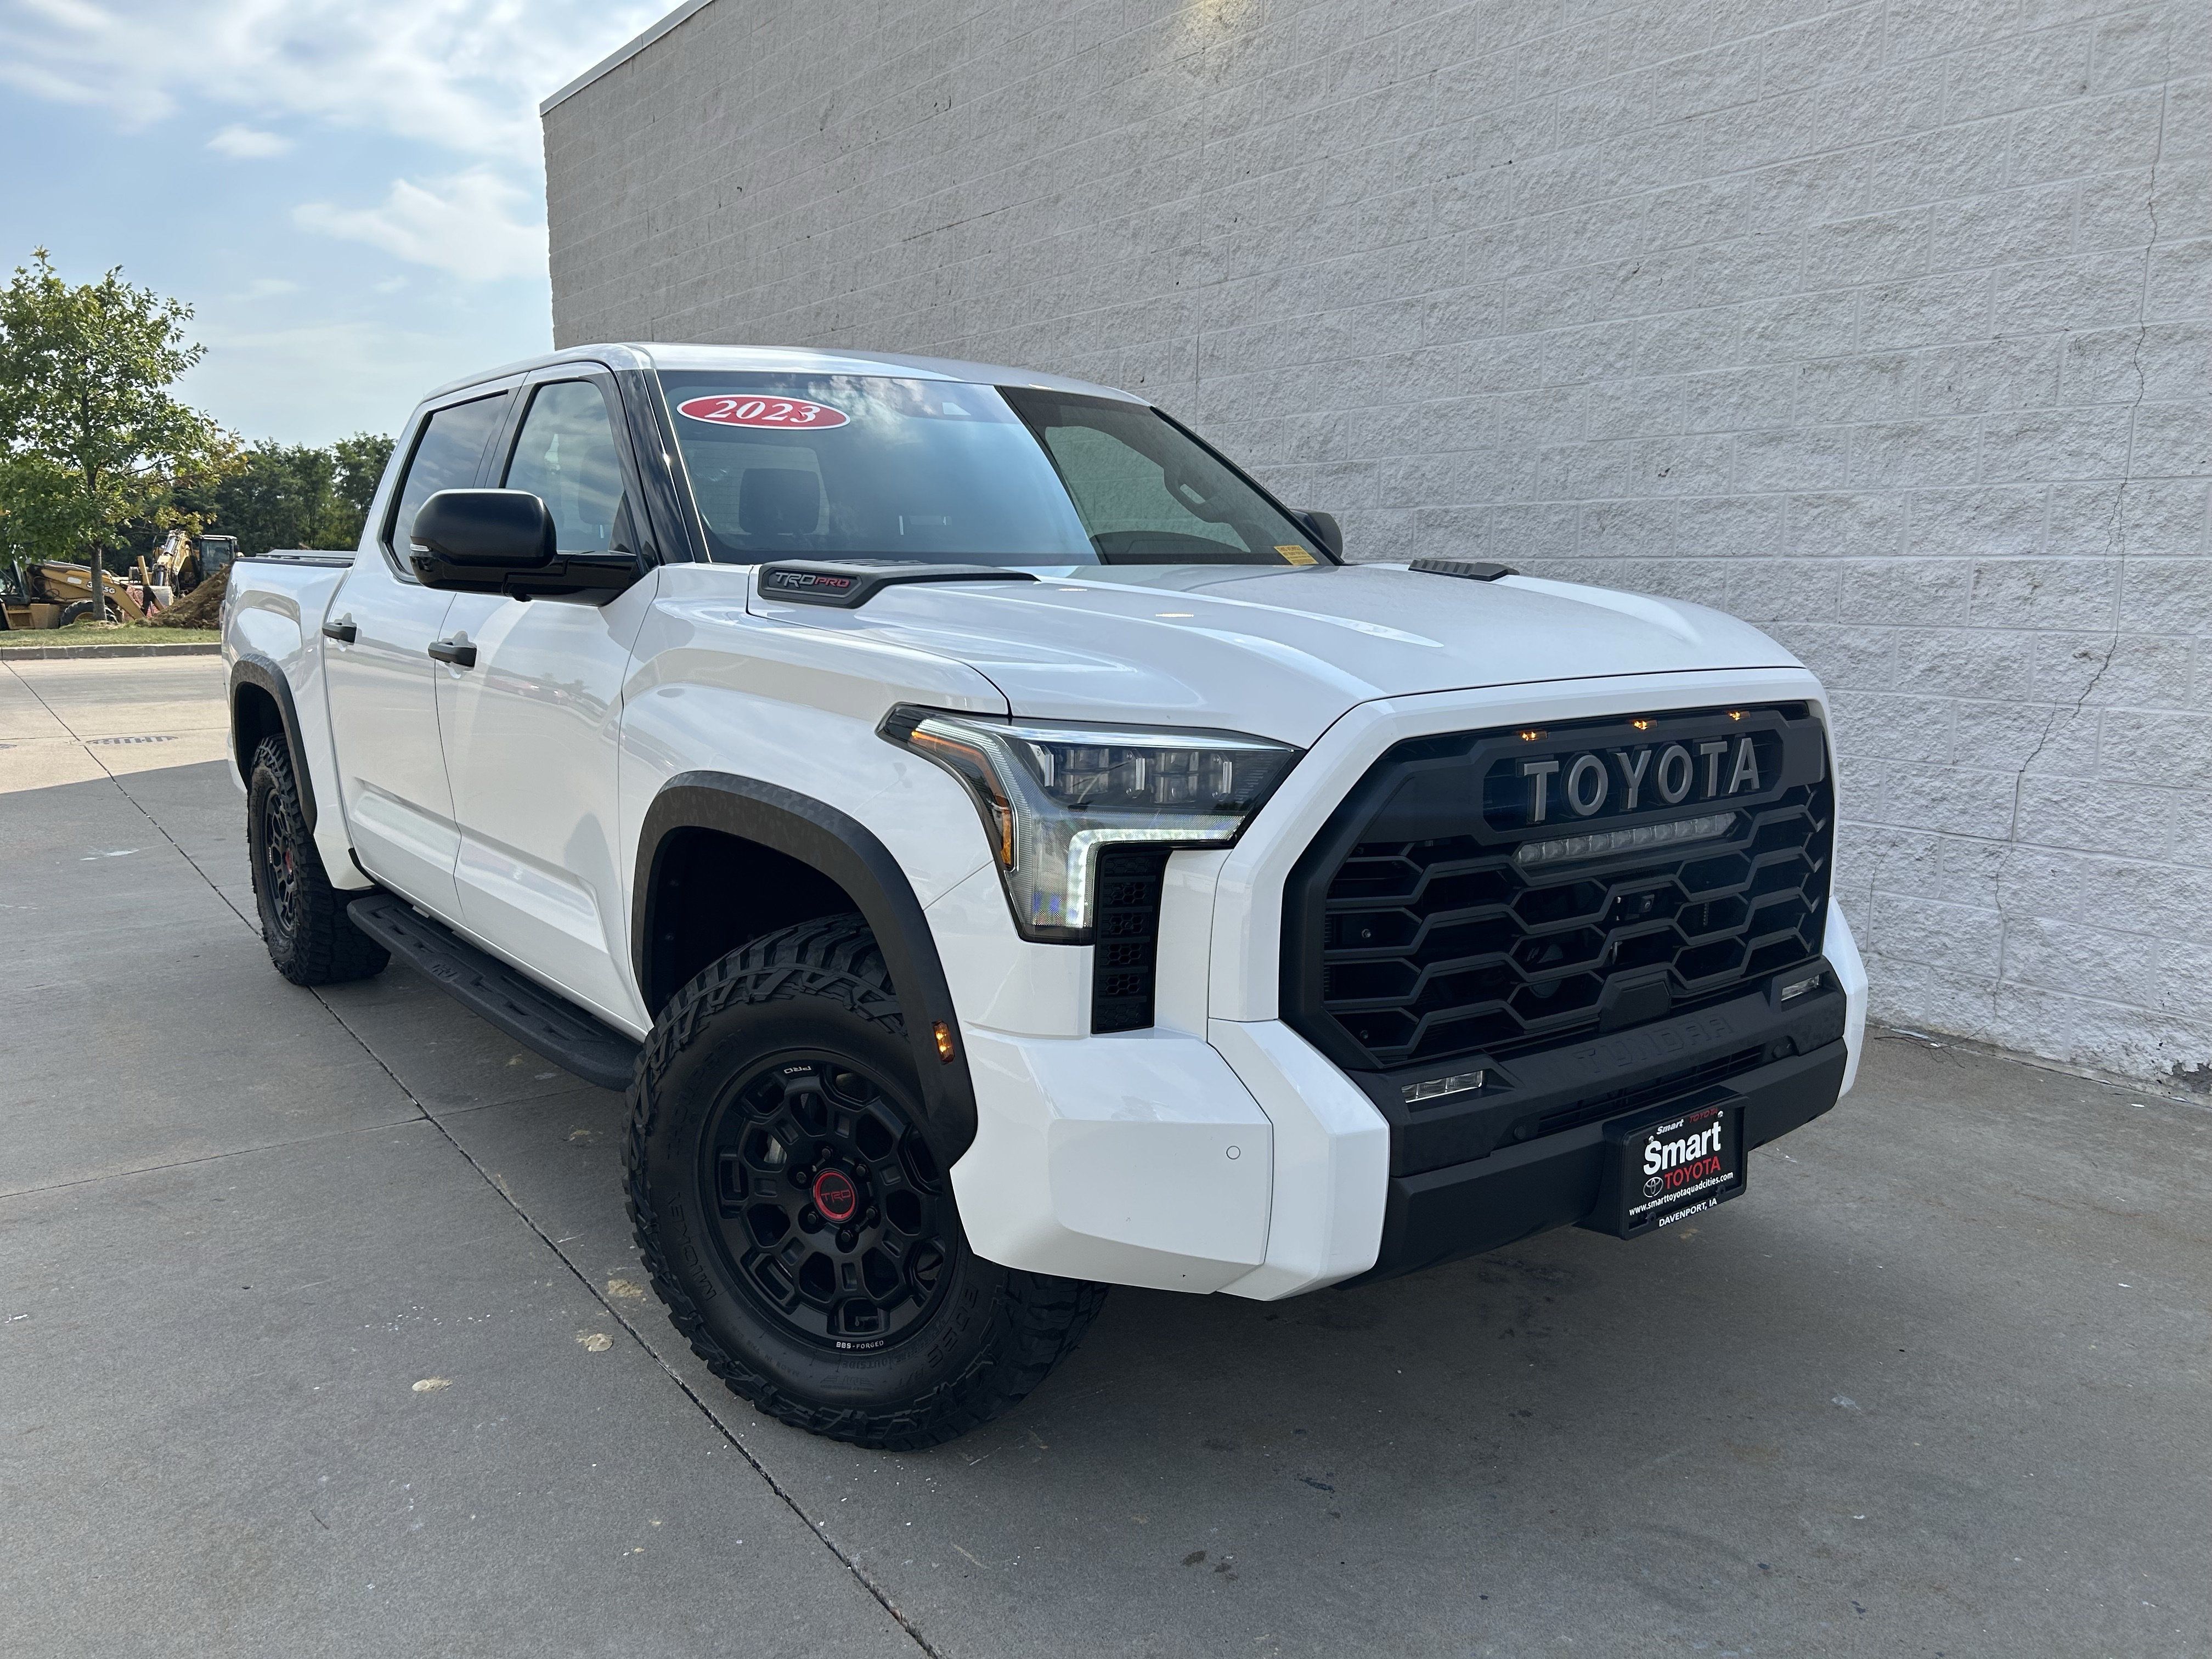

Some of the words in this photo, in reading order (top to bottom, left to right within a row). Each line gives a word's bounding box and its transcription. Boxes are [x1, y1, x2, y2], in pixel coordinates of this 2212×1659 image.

[704, 400, 821, 423] 2023
[1523, 737, 1760, 822] TOYOTA
[1572, 1015, 1735, 1073] TUNDRA
[783, 1065, 812, 1074] PRO
[1656, 1119, 1684, 1135] Smart
[1689, 1107, 1718, 1123] TOYOTA
[1644, 1121, 1722, 1175] Smart
[1664, 1156, 1721, 1189] TOYOTA
[821, 1189, 851, 1203] TRD
[1629, 1171, 1734, 1216] www.smarttoyotaquadcities.com
[1658, 1203, 1707, 1228] DAVENPORT,
[1709, 1198, 1718, 1206] IA
